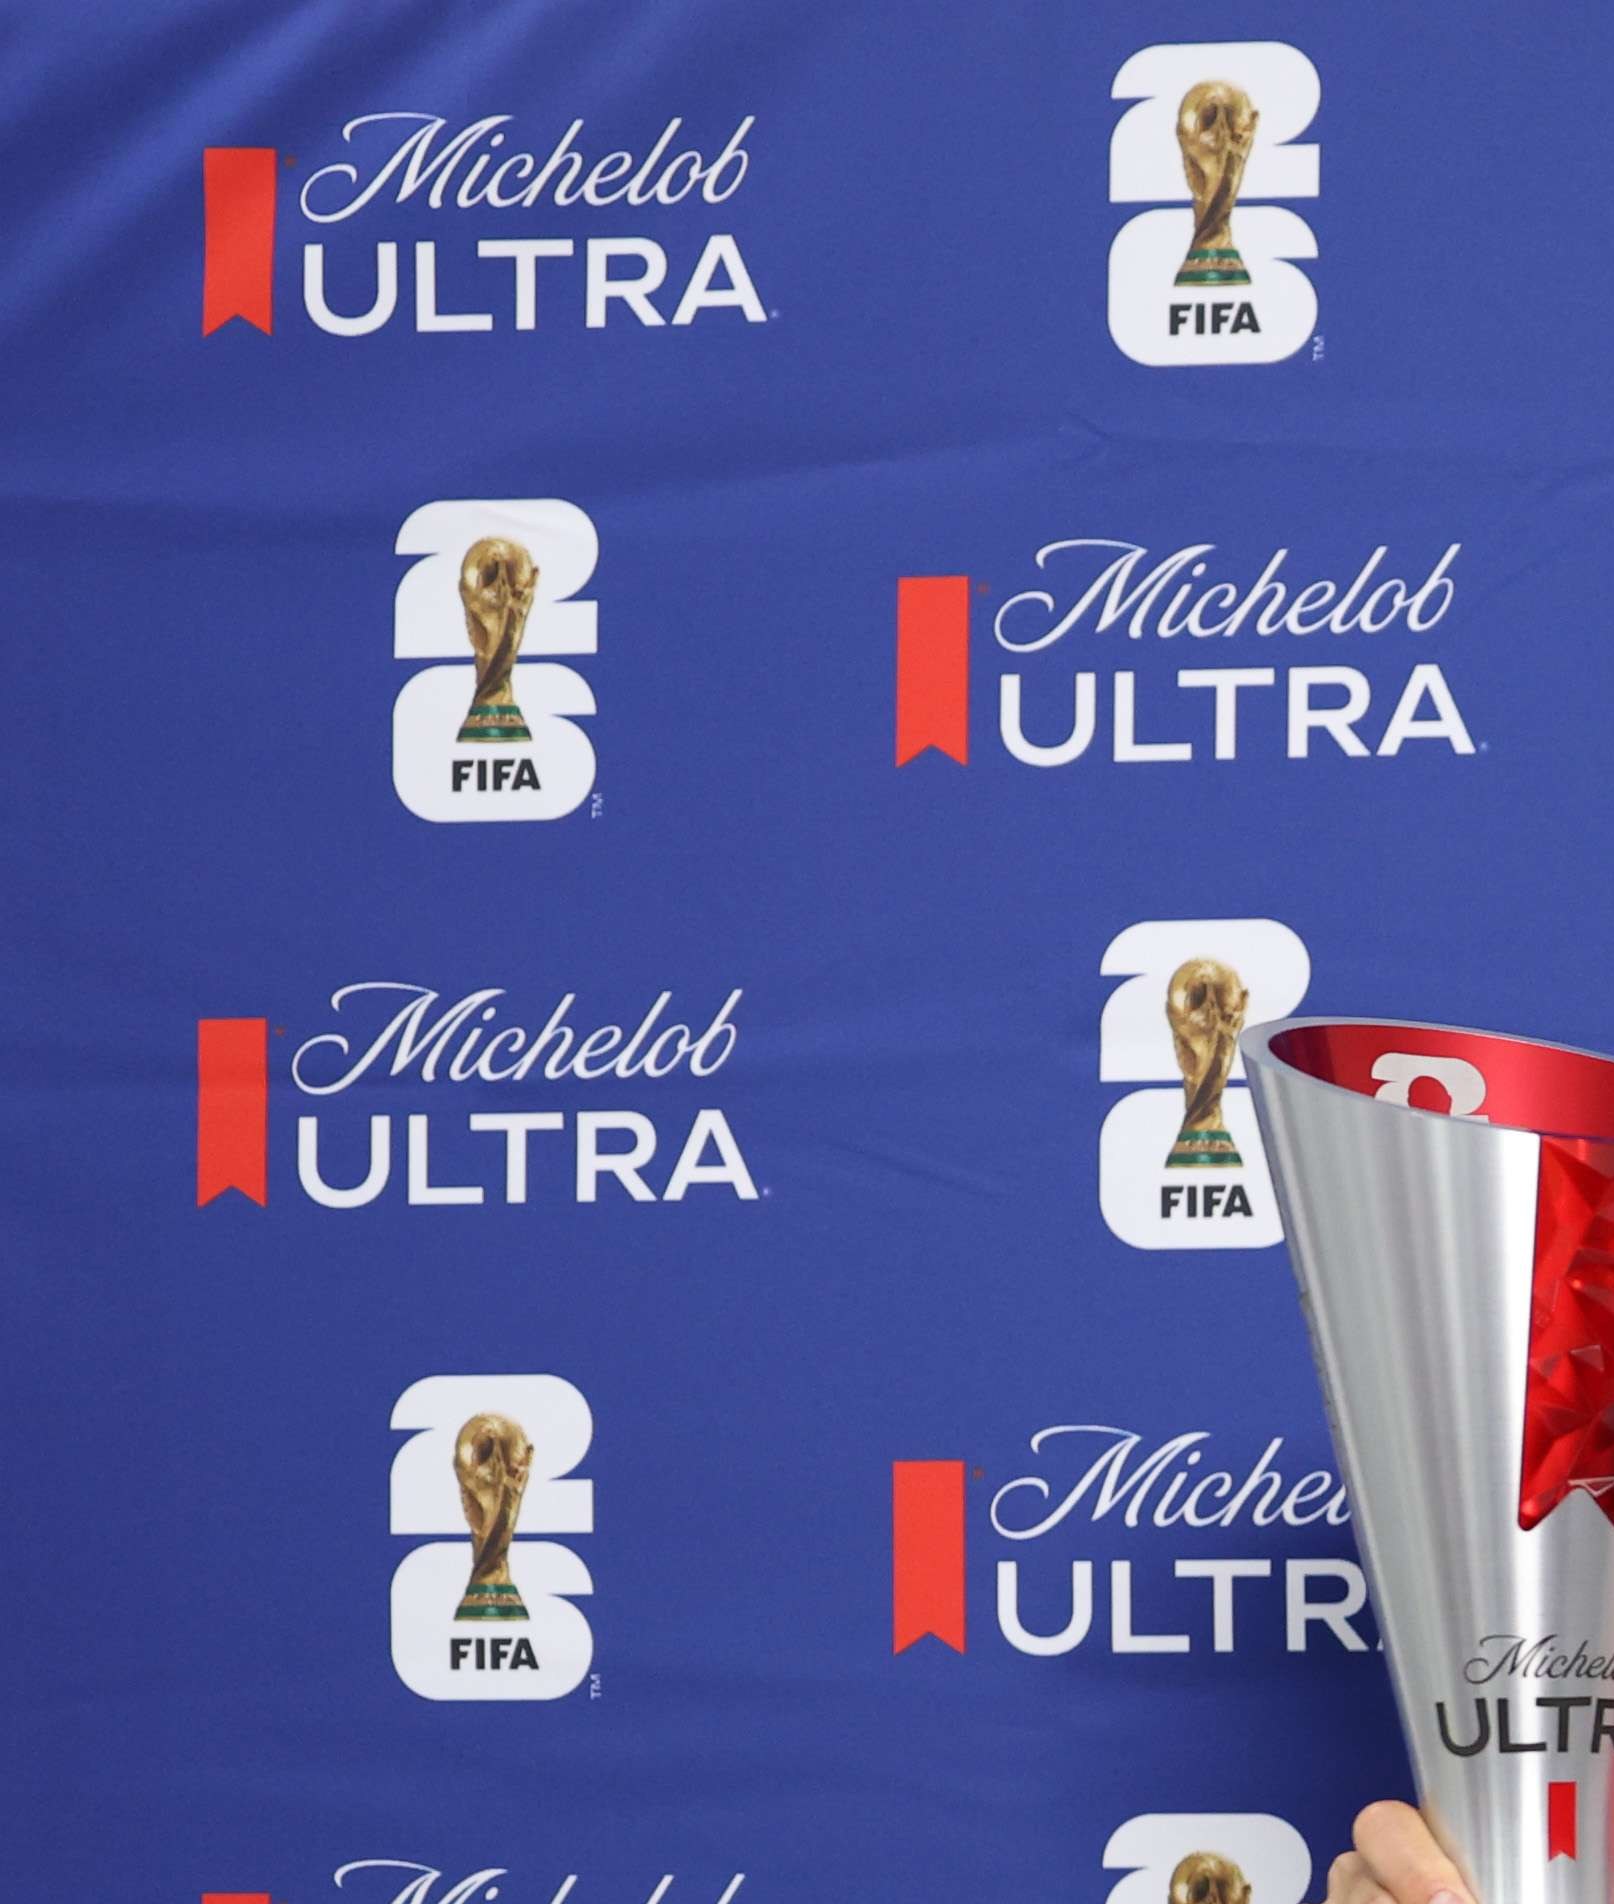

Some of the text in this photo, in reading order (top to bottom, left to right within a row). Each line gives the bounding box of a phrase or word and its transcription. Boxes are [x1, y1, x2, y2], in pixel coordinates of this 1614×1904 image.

[300, 112, 755, 223] Michelob
[304, 235, 767, 336] ULTRA
[1169, 302, 1261, 336] FIFA
[995, 539, 1461, 652] Michelob
[1000, 664, 1475, 767] ULTRA
[452, 758, 541, 792] FIFA
[292, 982, 742, 1095] Michelob
[298, 1109, 759, 1208] ULTRA
[1161, 1185, 1253, 1218] FIFA
[450, 1637, 540, 1670] FIFA
[997, 1558, 1383, 1656] ULTR
